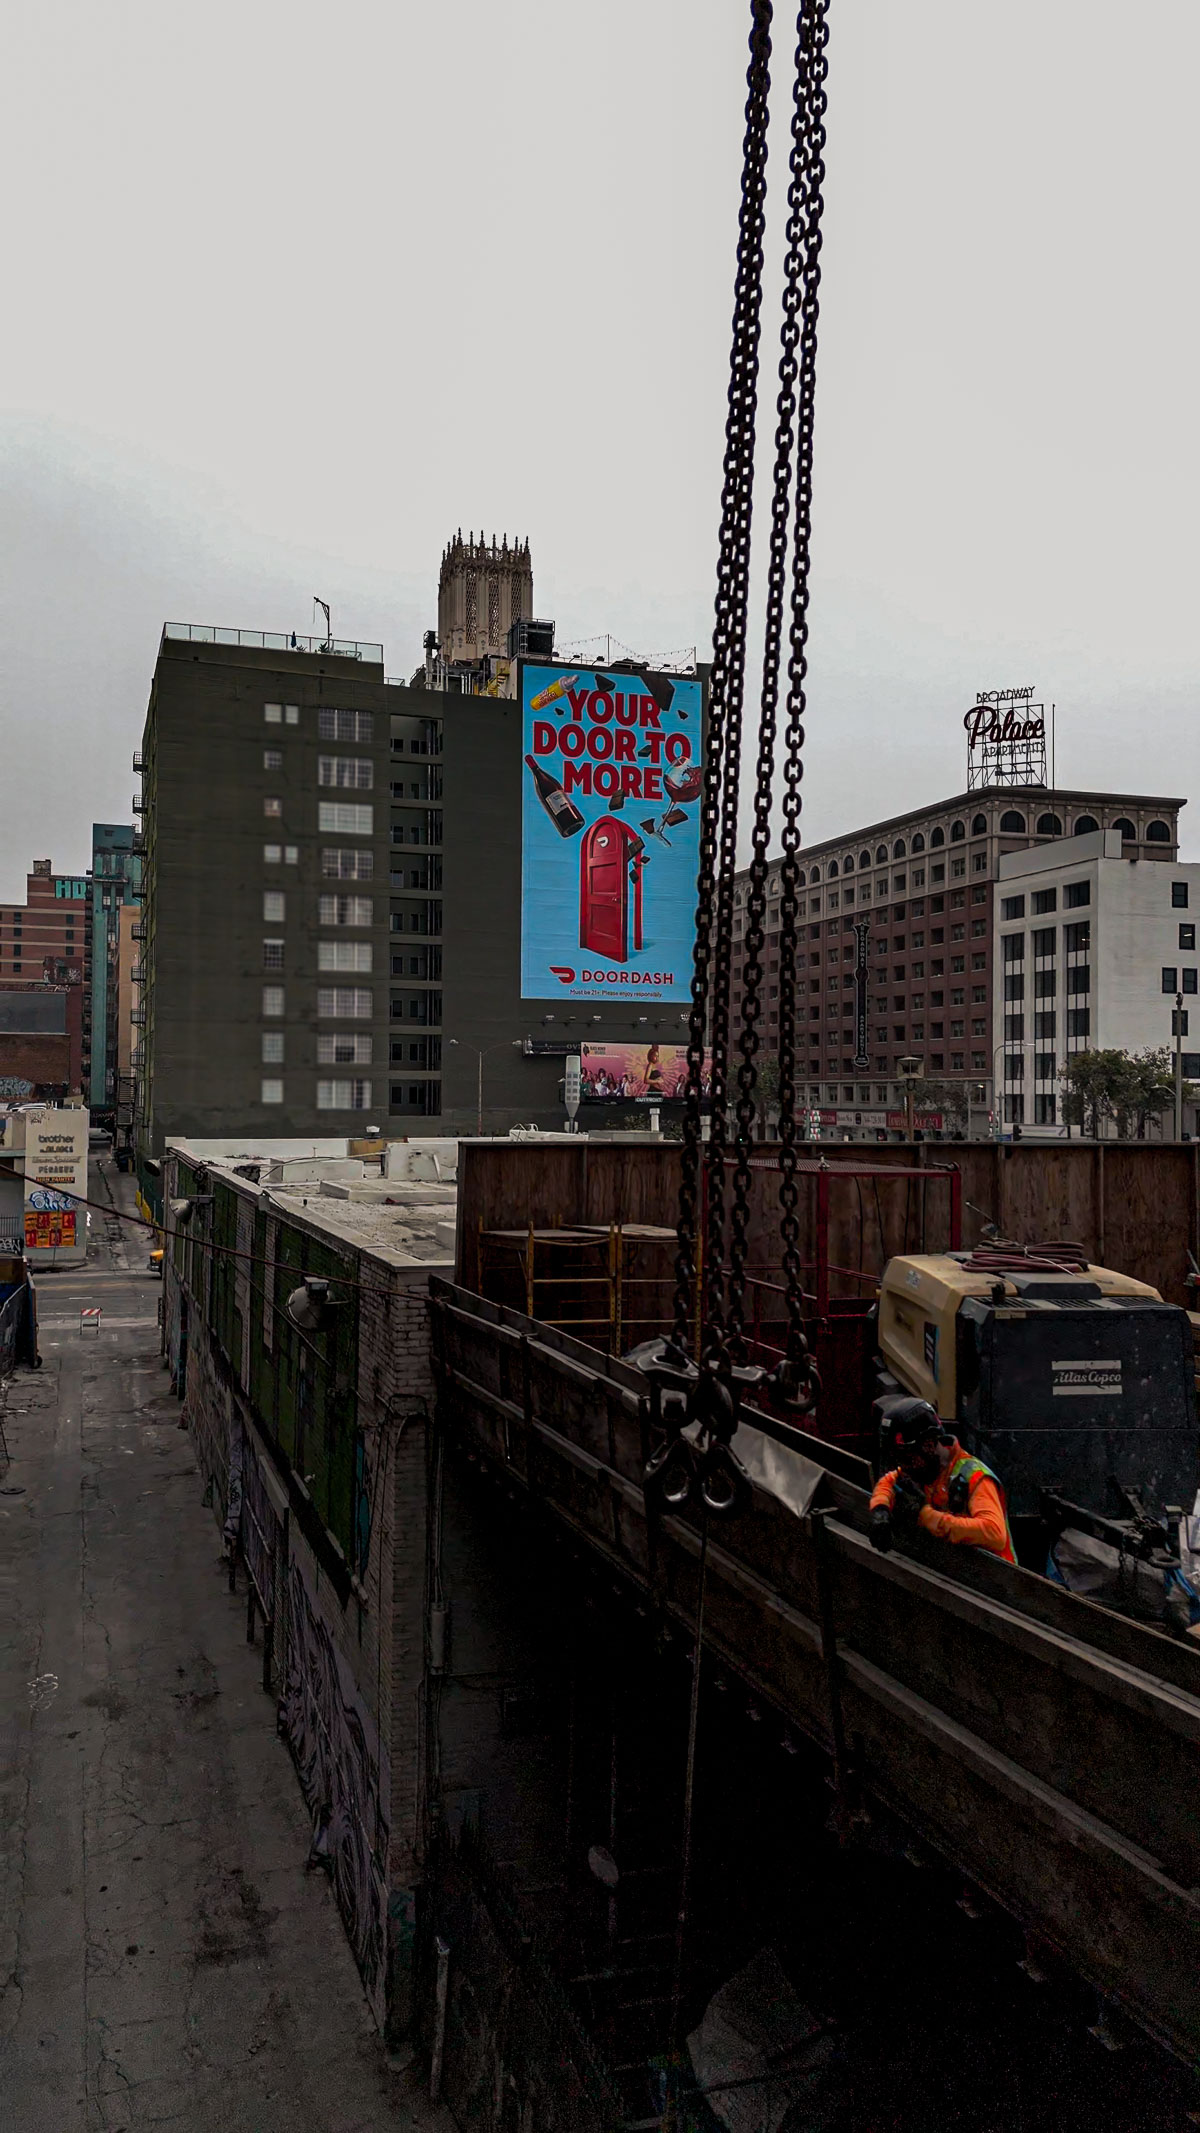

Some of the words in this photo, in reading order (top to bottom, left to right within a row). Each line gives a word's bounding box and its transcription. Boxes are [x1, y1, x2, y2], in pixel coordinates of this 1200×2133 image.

[567, 689, 661, 728] YOUR
[976, 686, 1035, 704] BROADWAY
[963, 706, 1046, 749] Palace
[533, 721, 637, 762] DOOR
[645, 731, 691, 767] TO
[563, 761, 663, 800] MORE
[582, 970, 673, 985] DOORDASH
[38, 1134, 75, 1143] brother
[1088, 1370, 1122, 1385] Copco
